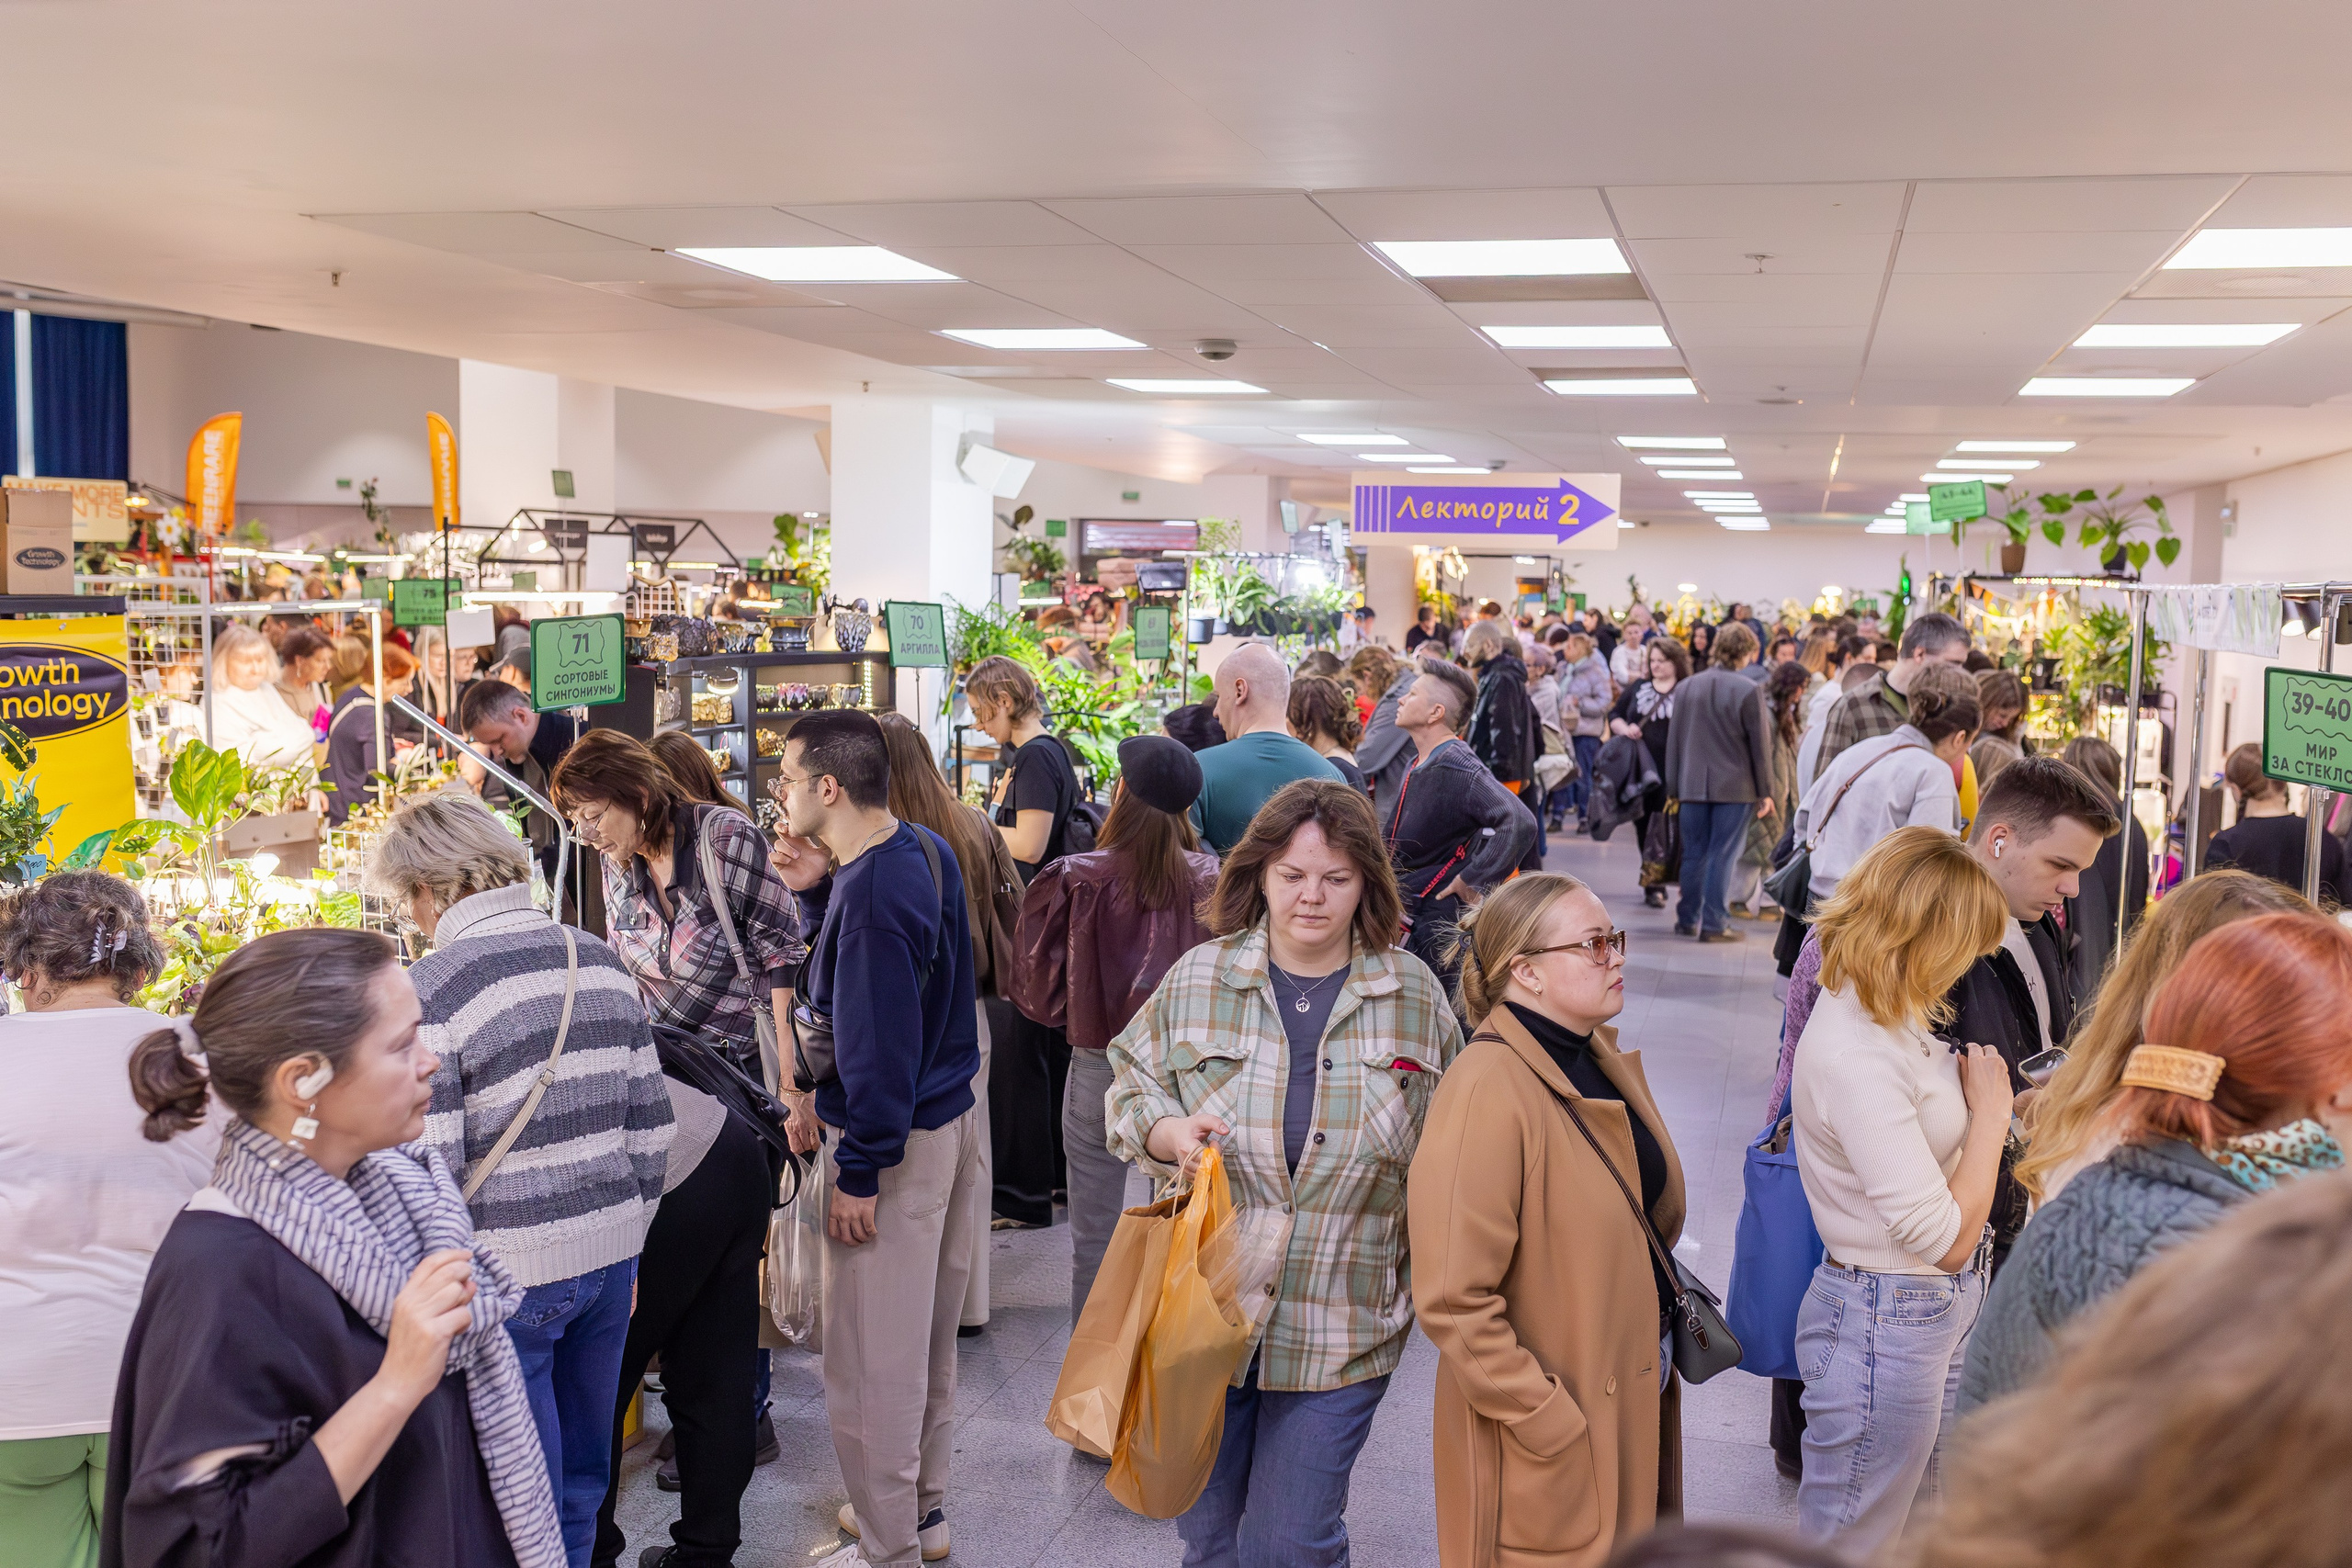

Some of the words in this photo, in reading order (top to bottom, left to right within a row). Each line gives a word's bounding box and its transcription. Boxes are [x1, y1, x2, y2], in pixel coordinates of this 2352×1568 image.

[70, 485, 124, 502] MORE
[73, 502, 126, 520] NTS
[1396, 495, 1550, 529] Лекторий
[1557, 493, 1580, 525] 2
[910, 615, 924, 630] 70
[571, 632, 590, 655] 71
[900, 642, 941, 655] АРГИЛЛА
[554, 669, 608, 685] СОРТОВЫЕ
[546, 683, 616, 702] СИНГОНИУМЫ
[2, 688, 111, 721] nology
[2291, 691, 2351, 722] 39-40
[2306, 742, 2337, 761] МИР
[2271, 755, 2290, 772] ЗА
